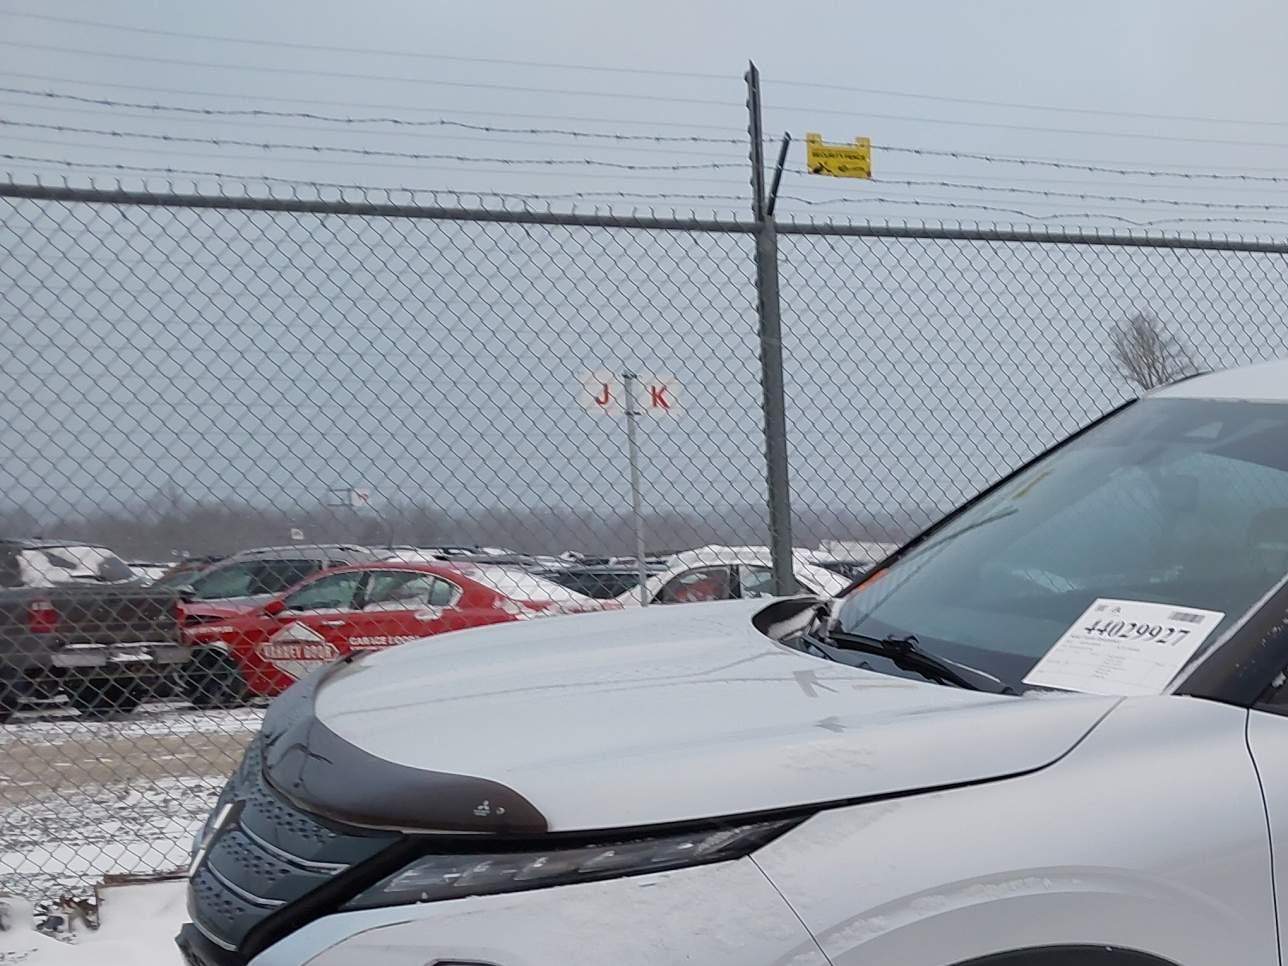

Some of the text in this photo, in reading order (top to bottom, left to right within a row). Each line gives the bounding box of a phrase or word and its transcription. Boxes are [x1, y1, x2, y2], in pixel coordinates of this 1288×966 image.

[594, 383, 608, 405] J
[651, 385, 670, 408] K
[1084, 620, 1191, 647] 44029927
